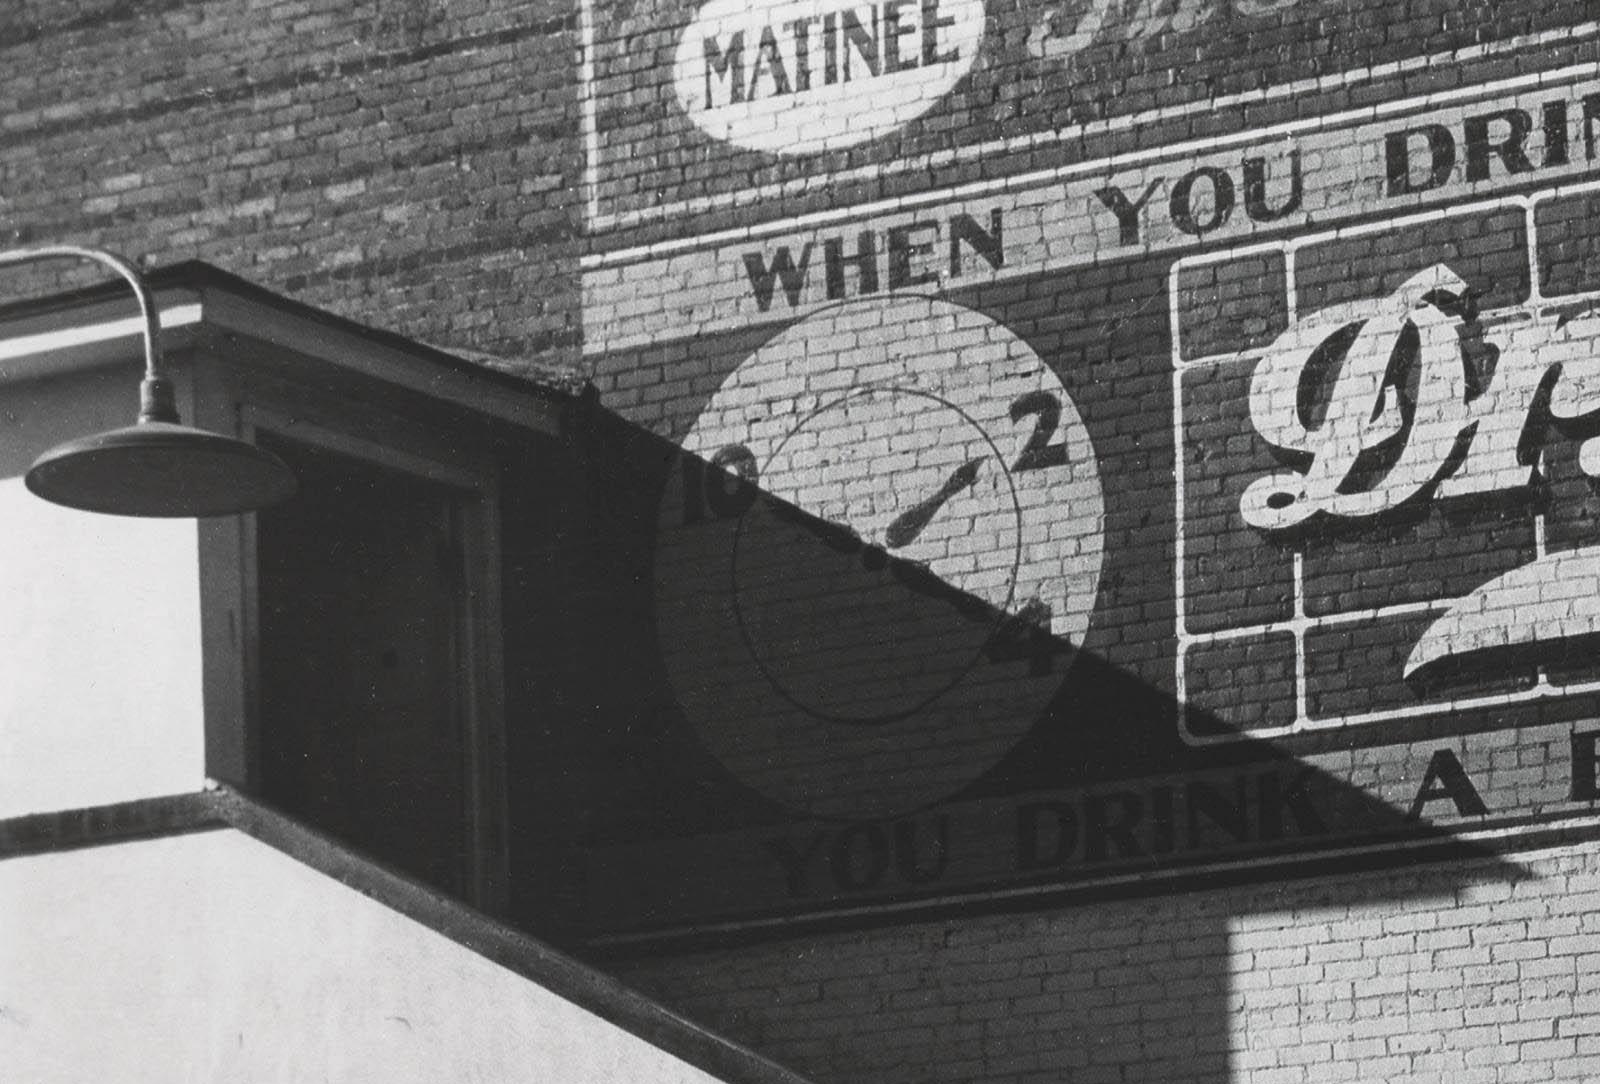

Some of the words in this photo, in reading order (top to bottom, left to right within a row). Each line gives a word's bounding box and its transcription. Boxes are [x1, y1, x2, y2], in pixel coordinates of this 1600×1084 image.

[703, 6, 961, 113] MATINEE
[742, 208, 1006, 314] WHEN
[1094, 148, 1304, 247] YOU
[1008, 389, 1071, 473] 2
[988, 600, 1054, 677] 4
[763, 813, 951, 898] YOU
[1016, 766, 1329, 873] DRINK
[1408, 748, 1490, 821] A
